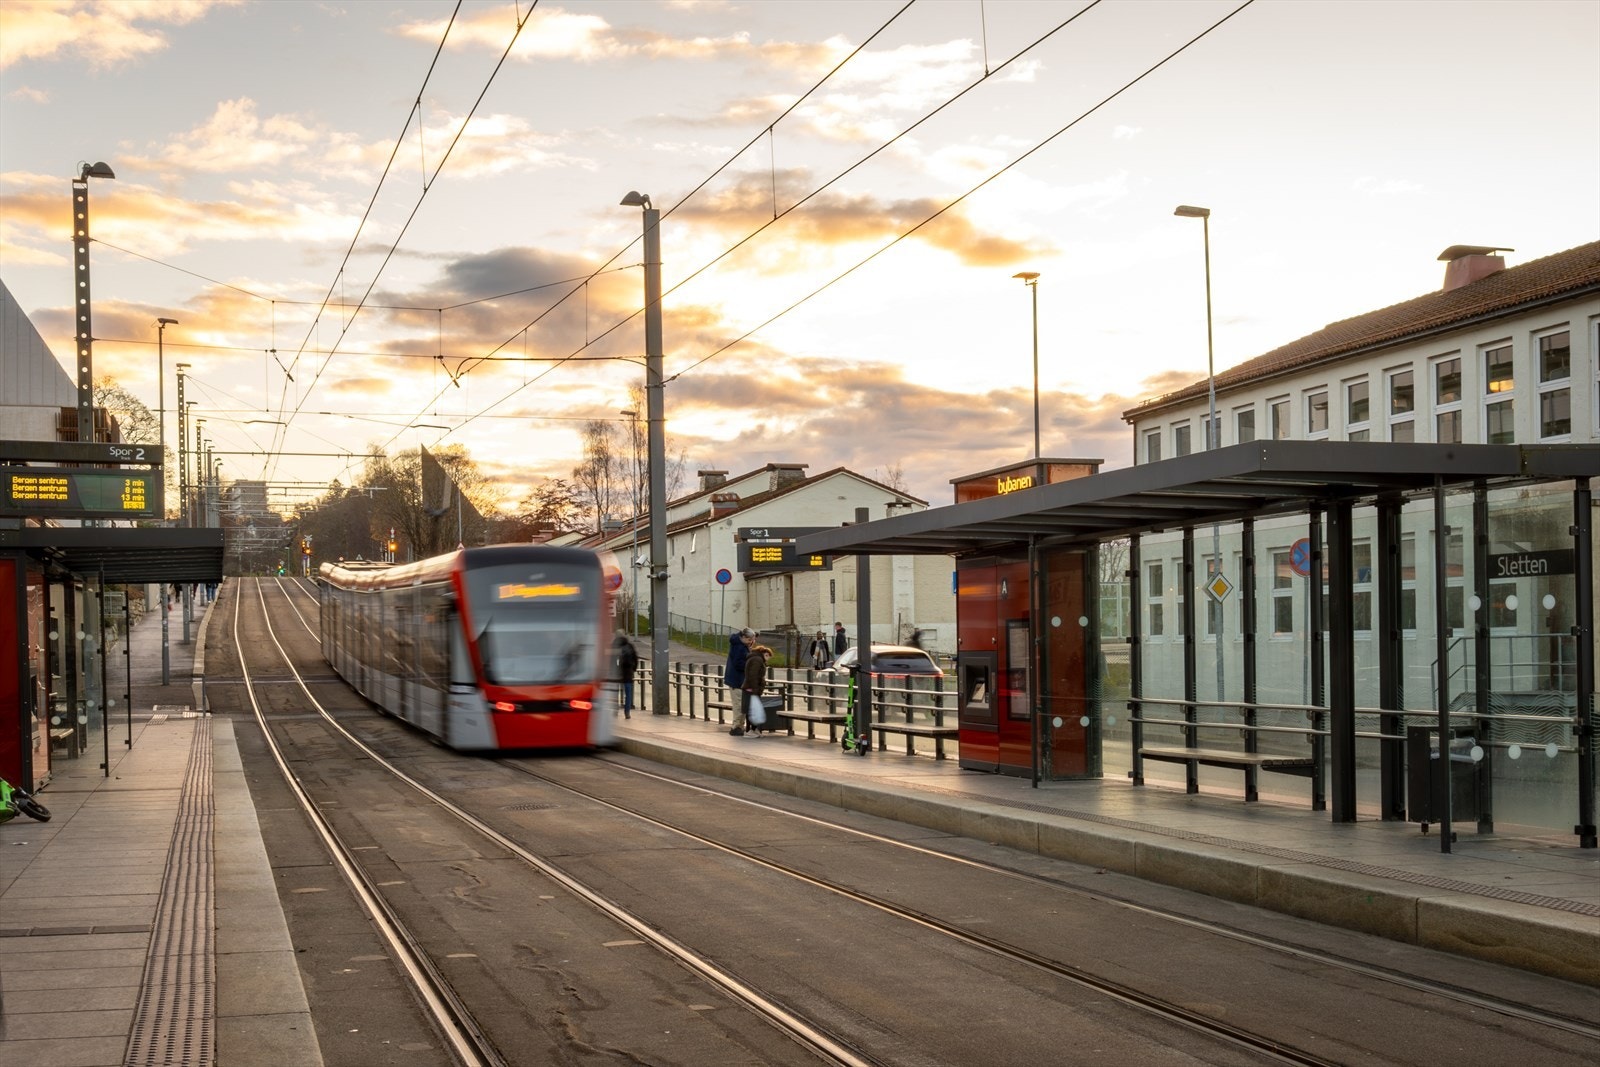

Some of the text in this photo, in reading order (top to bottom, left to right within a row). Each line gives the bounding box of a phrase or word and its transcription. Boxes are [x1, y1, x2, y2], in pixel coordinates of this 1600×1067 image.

[110, 446, 145, 460] Spor 2
[998, 476, 1032, 495] bybanen
[1498, 555, 1547, 576] Sletten
[1001, 580, 1007, 594] A
